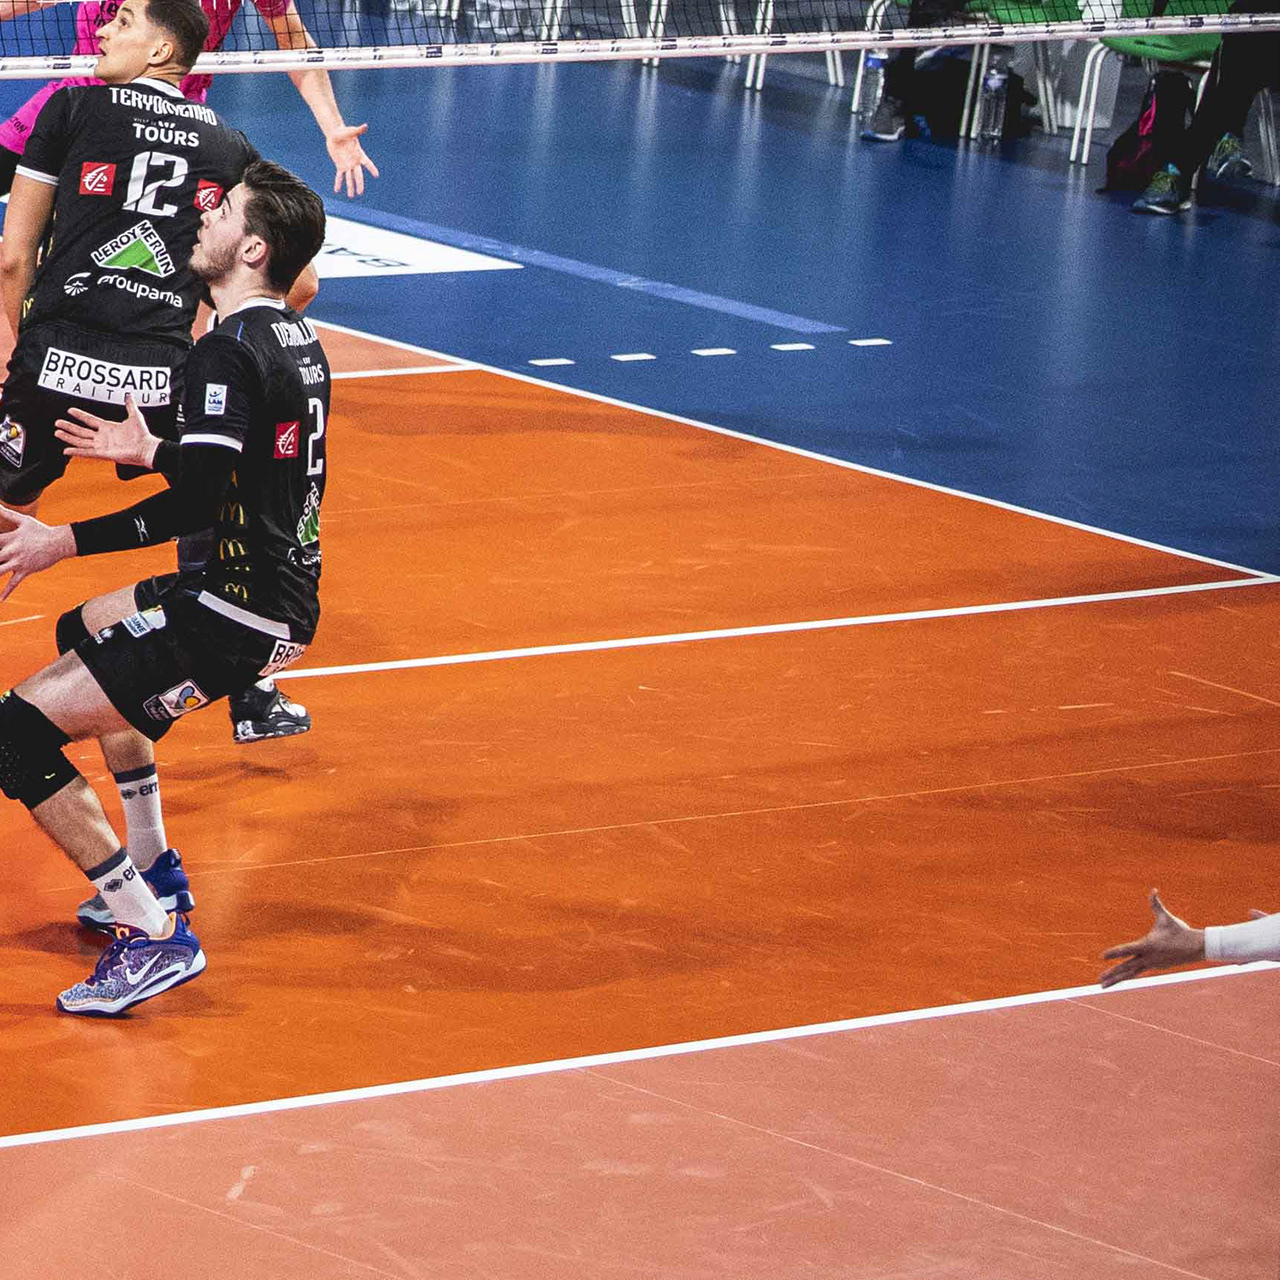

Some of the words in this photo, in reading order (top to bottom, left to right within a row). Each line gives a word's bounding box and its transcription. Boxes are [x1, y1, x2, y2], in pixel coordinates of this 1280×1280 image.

[132, 122, 200, 148] TOURS
[122, 150, 189, 218] 12
[92, 227, 138, 263] LEROY
[137, 221, 174, 275] MERLIN
[45, 352, 169, 390] BROSSARD
[306, 397, 325, 476] 2
